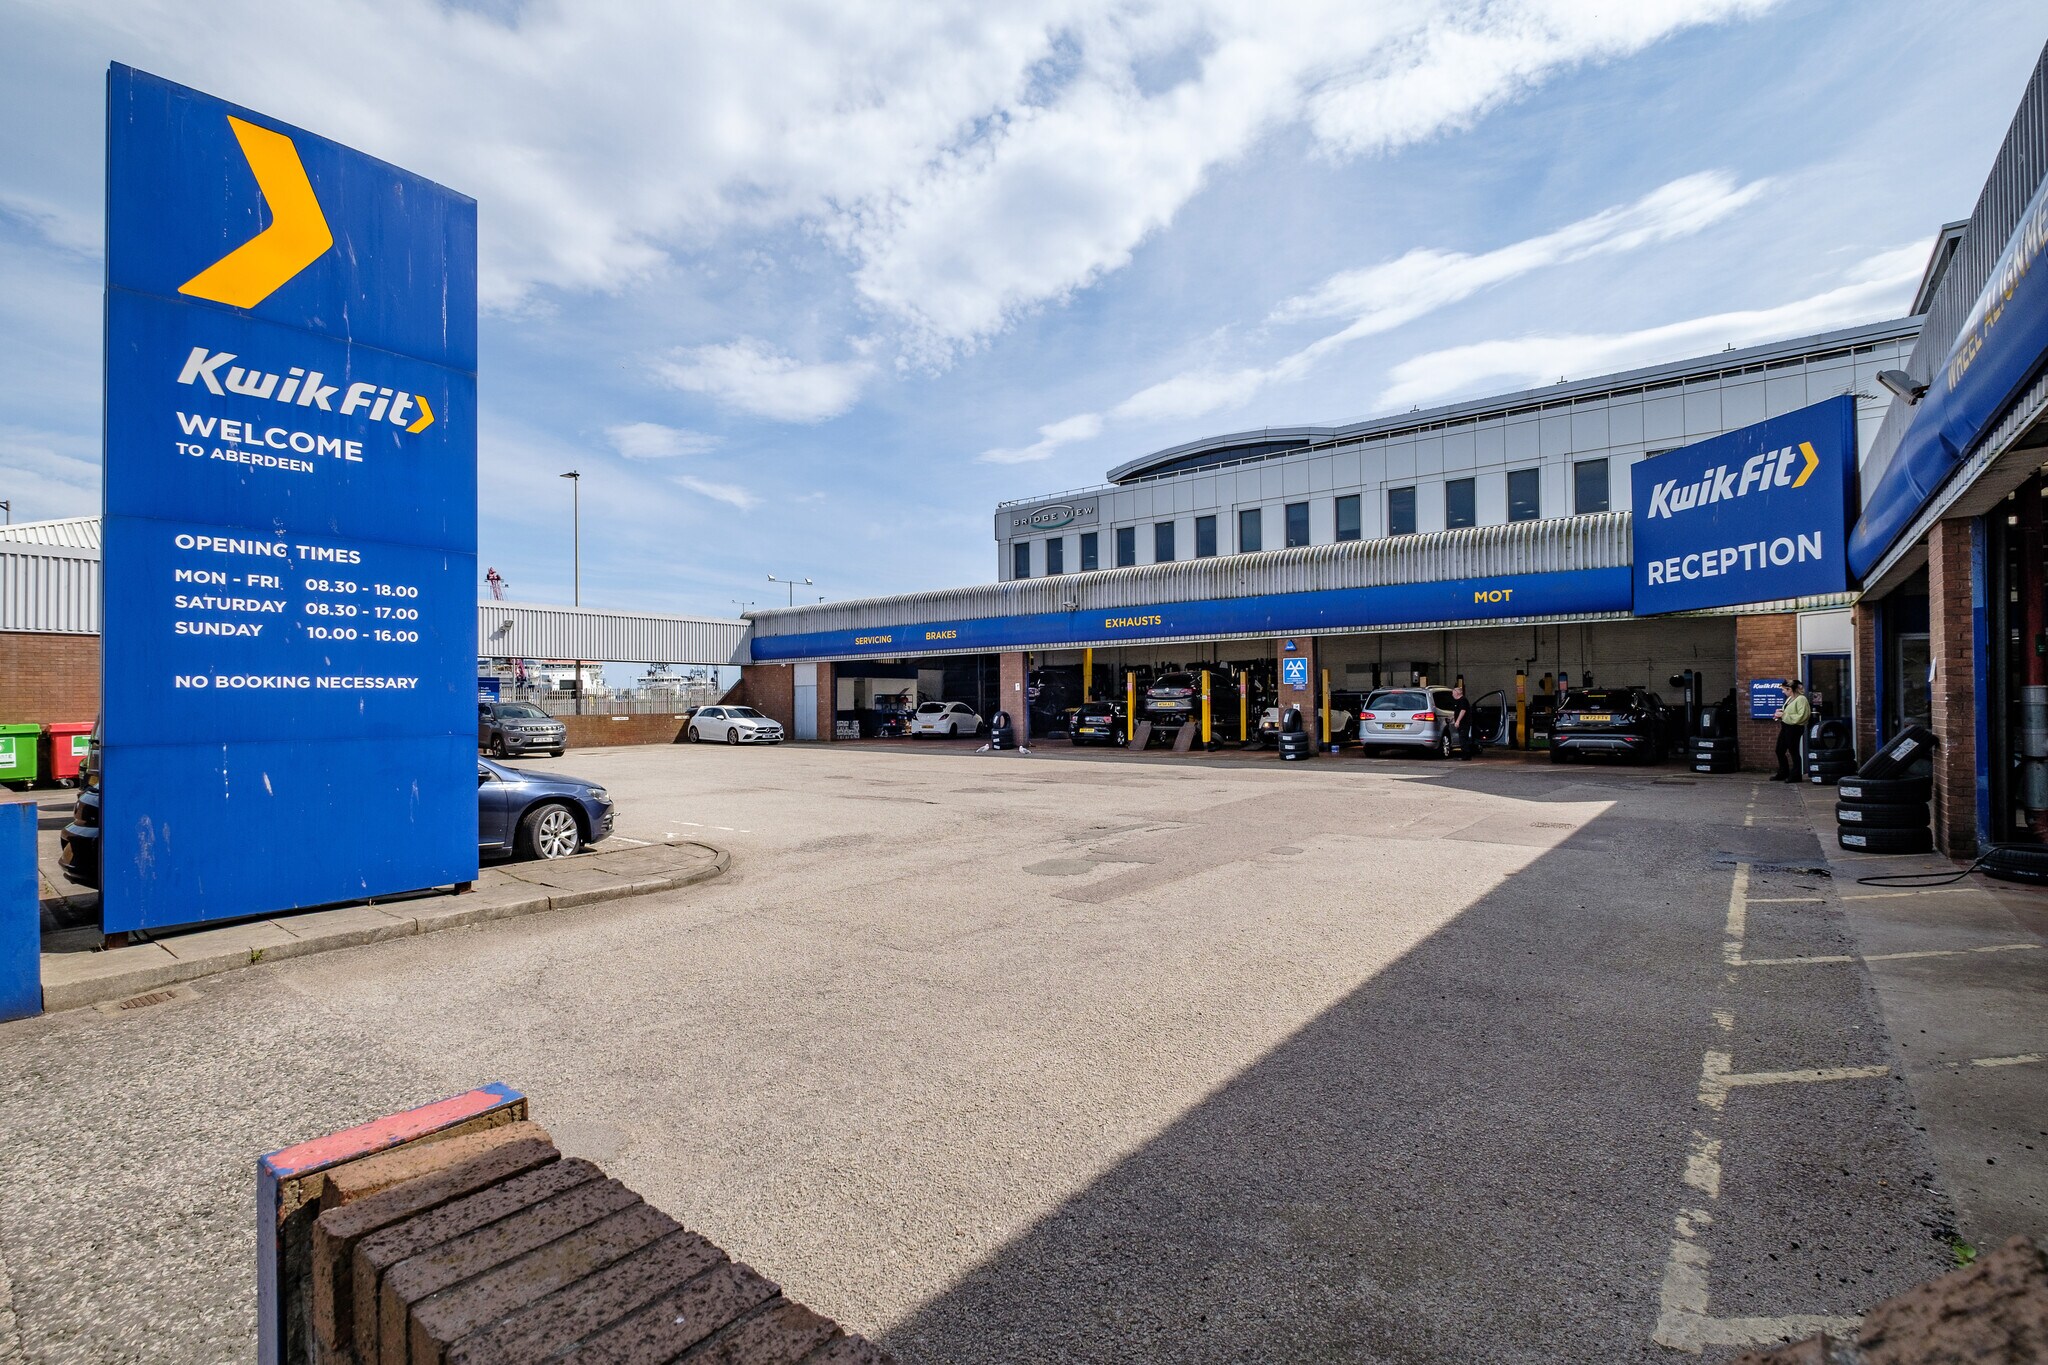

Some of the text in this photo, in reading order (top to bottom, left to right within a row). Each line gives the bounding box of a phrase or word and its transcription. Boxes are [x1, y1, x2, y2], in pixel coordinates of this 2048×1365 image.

[176, 411, 363, 463] WELCOME
[176, 443, 314, 473] TO ABERDEEN
[1013, 507, 1094, 526] BRIDGE VIEW
[175, 534, 361, 564] OPENING TIMES
[1648, 530, 1822, 586] RECEPTION
[175, 569, 226, 585] MON
[247, 574, 280, 589] FRI
[305, 578, 357, 594] 08.30
[374, 583, 419, 598] 18.00
[1474, 589, 1513, 604] MOT
[175, 595, 287, 613] SATURDAY
[305, 602, 357, 617] 08.30
[374, 606, 419, 621] 17.00
[175, 621, 263, 637] SUNDAY
[306, 626, 357, 641] 10.00
[374, 628, 419, 643] 16.00
[1105, 615, 1162, 628] EXHAUSTS
[855, 635, 892, 645] SERVICING
[925, 630, 957, 640] BRAKES
[175, 675, 419, 690] NO BOOKING NECESSARY
